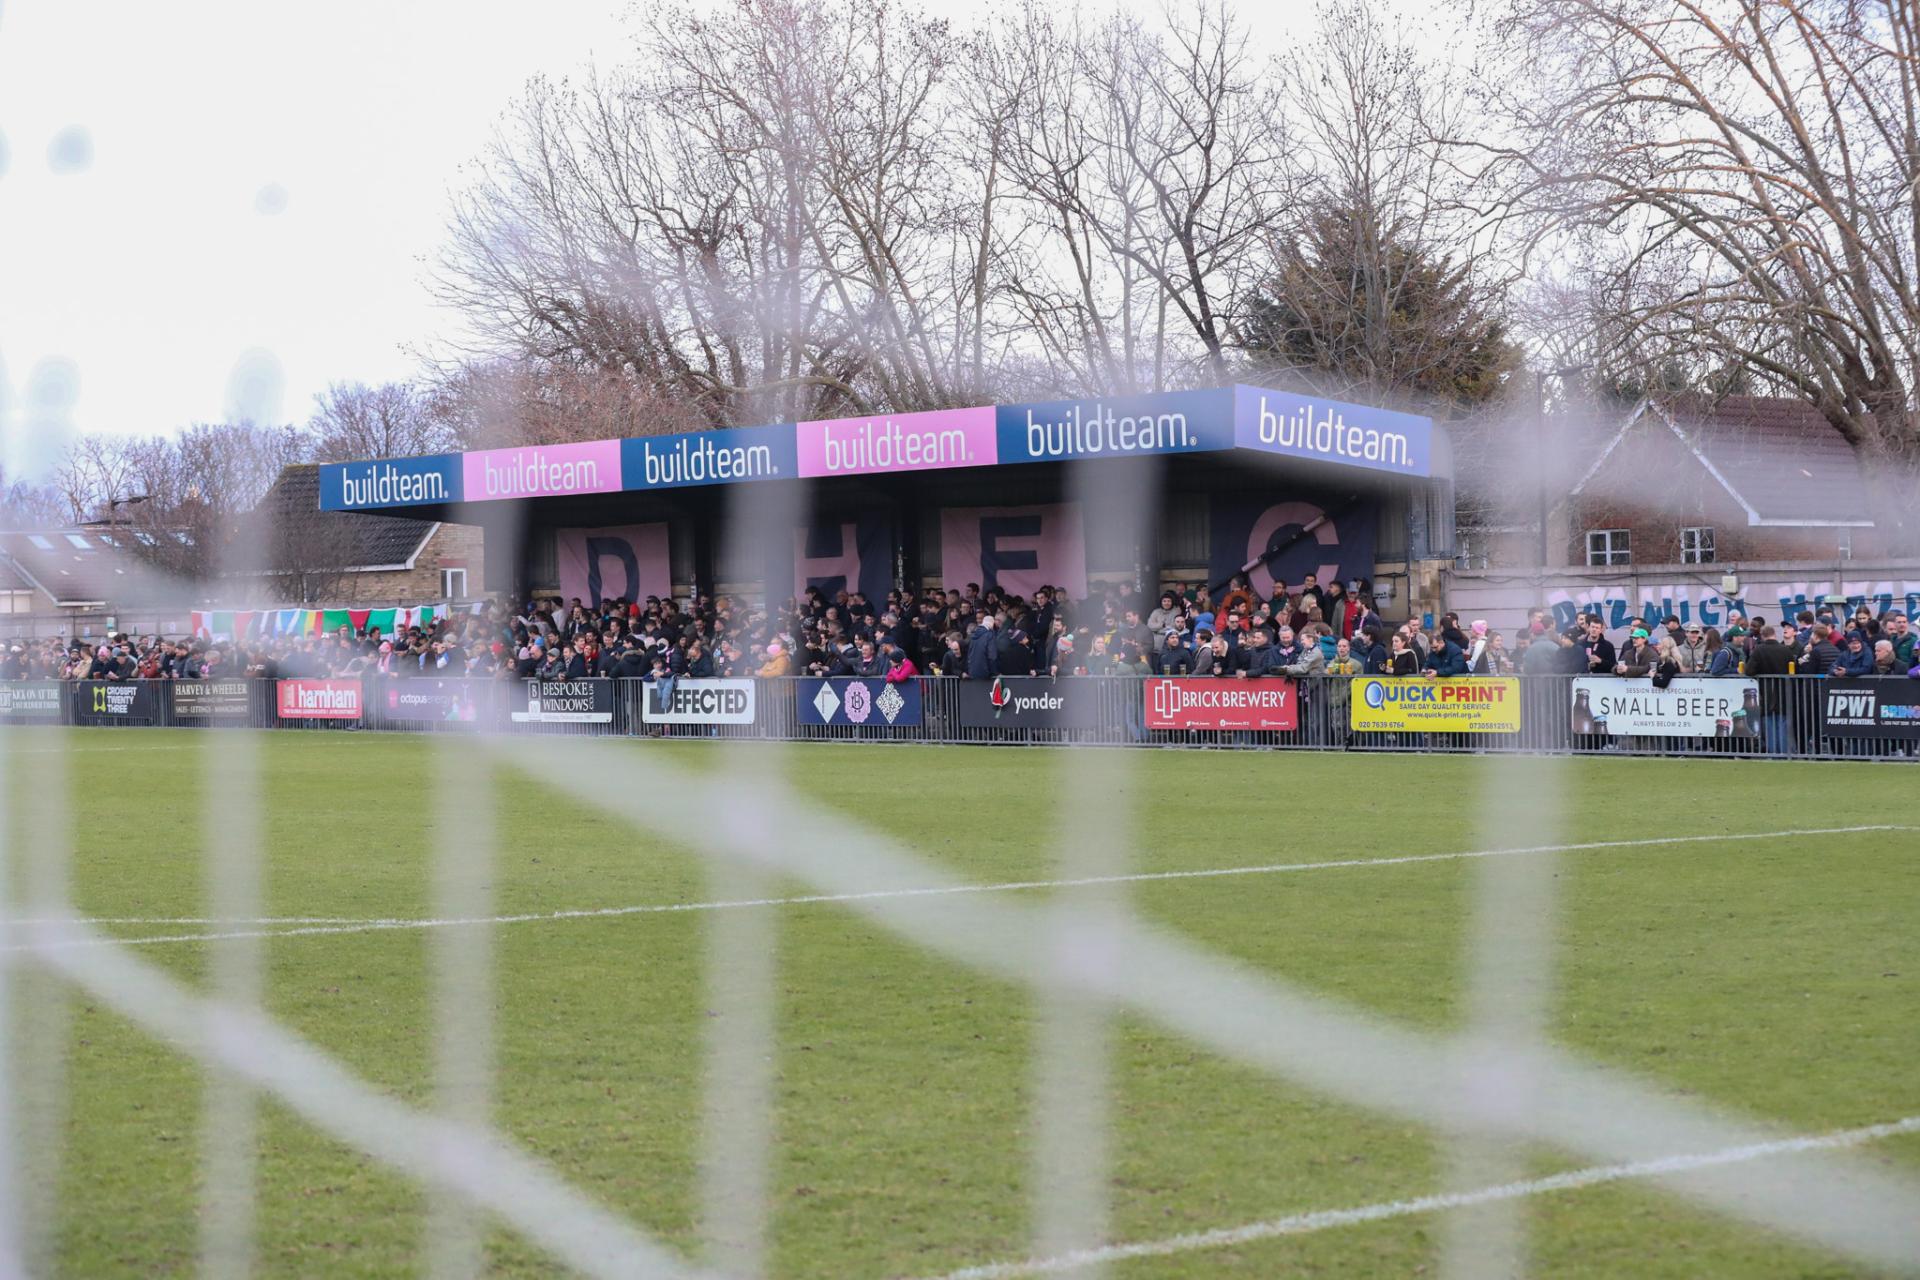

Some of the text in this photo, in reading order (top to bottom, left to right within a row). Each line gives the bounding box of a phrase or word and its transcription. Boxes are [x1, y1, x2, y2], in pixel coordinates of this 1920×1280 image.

[980, 516, 1042, 597] F
[1247, 502, 1341, 601] C
[587, 537, 640, 607] D
[106, 686, 137, 696] CROSSFIT
[175, 684, 248, 695] HARVEY & WHEELER
[542, 682, 588, 696] BESPOKE
[1365, 681, 1507, 711] QUICK PRINT
[106, 696, 134, 705] TWENTY
[543, 698, 588, 711] WINDOWS
[1014, 692, 1064, 714] yonder
[1183, 691, 1286, 707] BRICK BREWERY
[1600, 697, 1728, 717] SMALL BEER
[1827, 696, 1876, 717] IPW1
[106, 704, 128, 713] THREE
